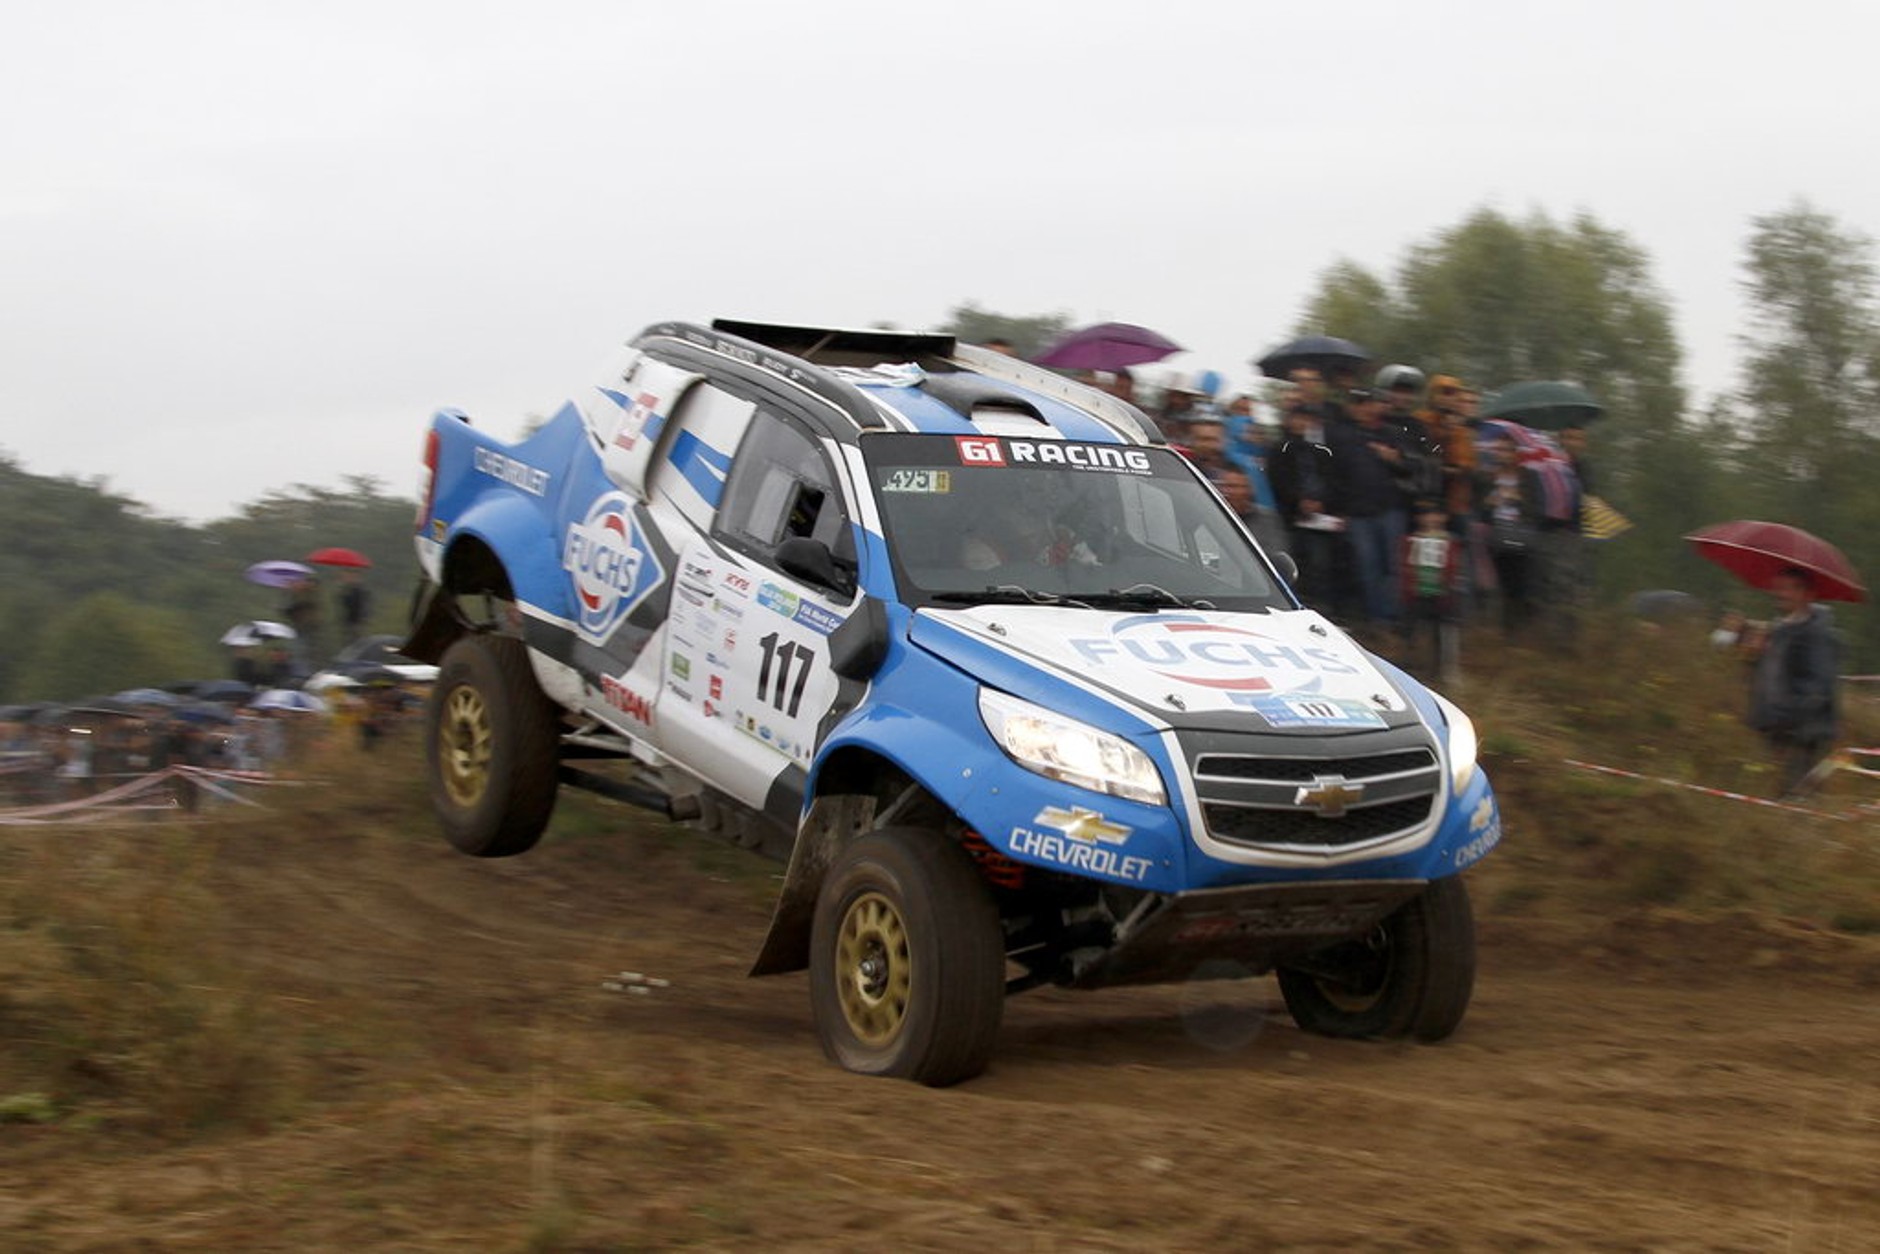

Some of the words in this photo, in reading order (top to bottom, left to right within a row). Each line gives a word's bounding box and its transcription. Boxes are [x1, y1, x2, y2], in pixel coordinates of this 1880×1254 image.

[474, 445, 551, 498] CHEVROLET
[960, 441, 1001, 462] G1
[1009, 441, 1151, 470] RACING
[568, 529, 637, 594] FUCHS
[756, 631, 816, 720] 117
[1068, 638, 1361, 675] FUCHS
[1299, 702, 1336, 718] 117
[1009, 826, 1154, 882] CHEVROLET
